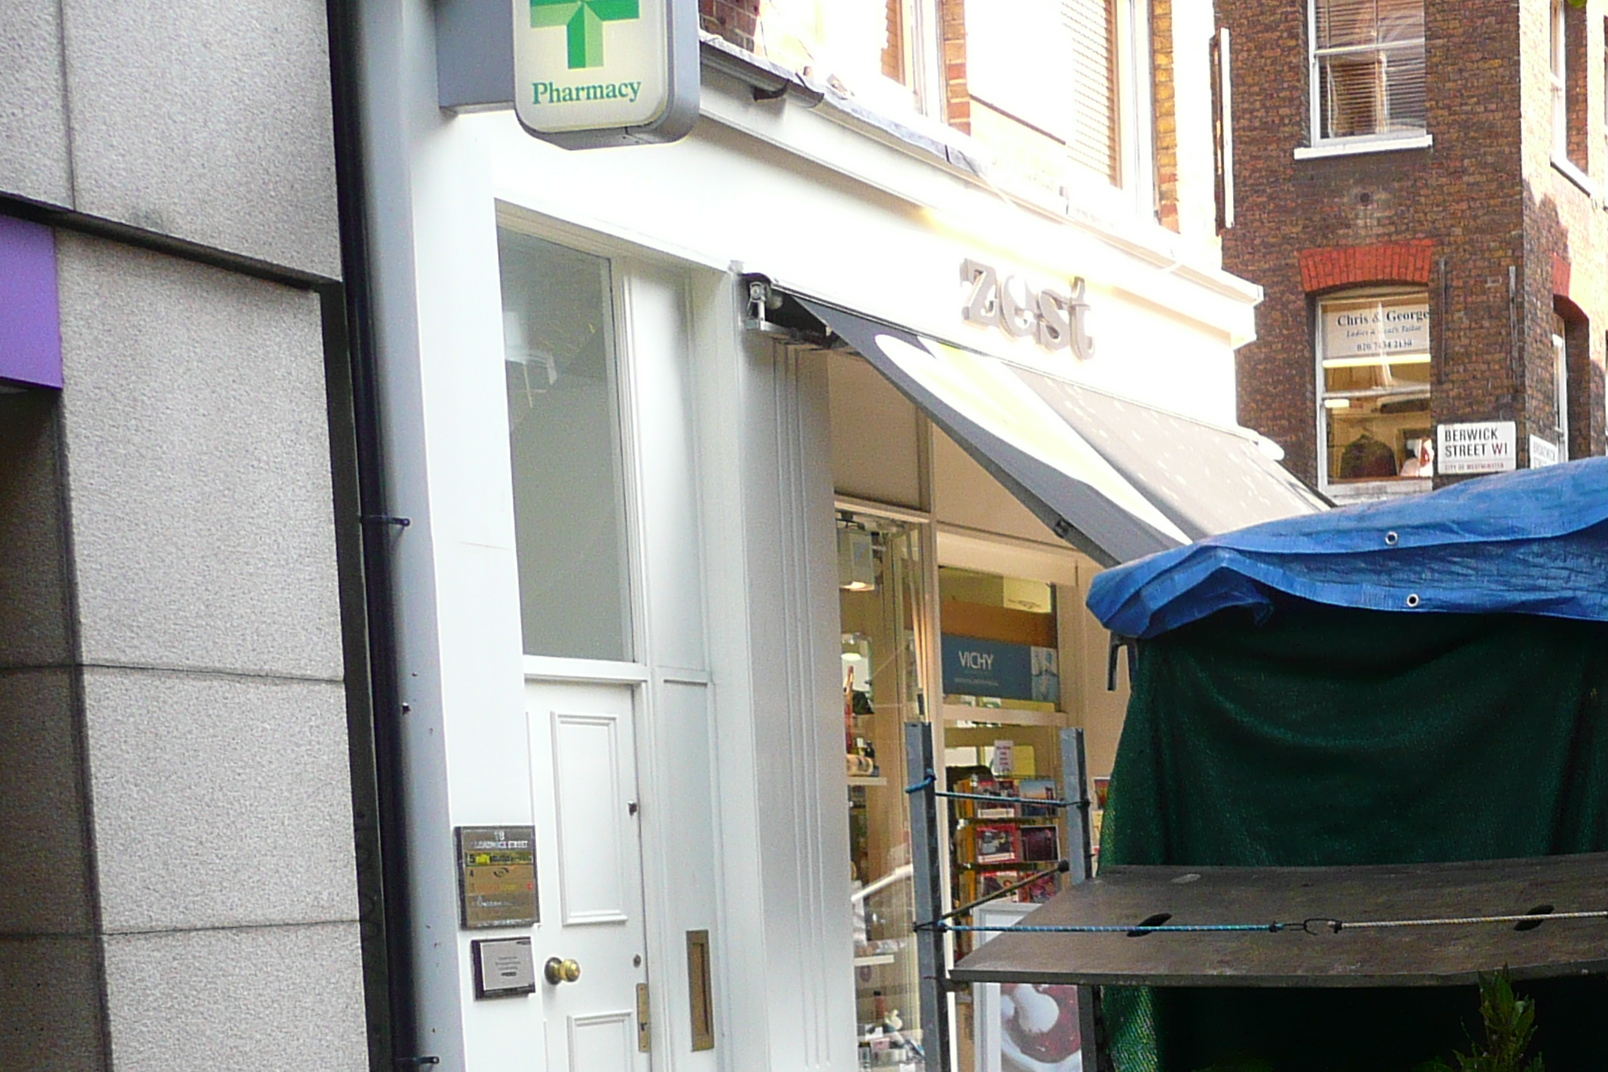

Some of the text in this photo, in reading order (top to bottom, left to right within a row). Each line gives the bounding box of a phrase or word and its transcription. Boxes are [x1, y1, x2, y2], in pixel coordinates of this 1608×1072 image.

[532, 81, 642, 105] Pharmacy
[960, 258, 1095, 360] zest
[1337, 313, 1369, 327] Chris
[1444, 428, 1498, 442] BERWICK
[1444, 443, 1486, 457] STREET
[1445, 462, 1504, 471] CITY OF WESTMINSTER
[959, 651, 994, 670] VICHY
